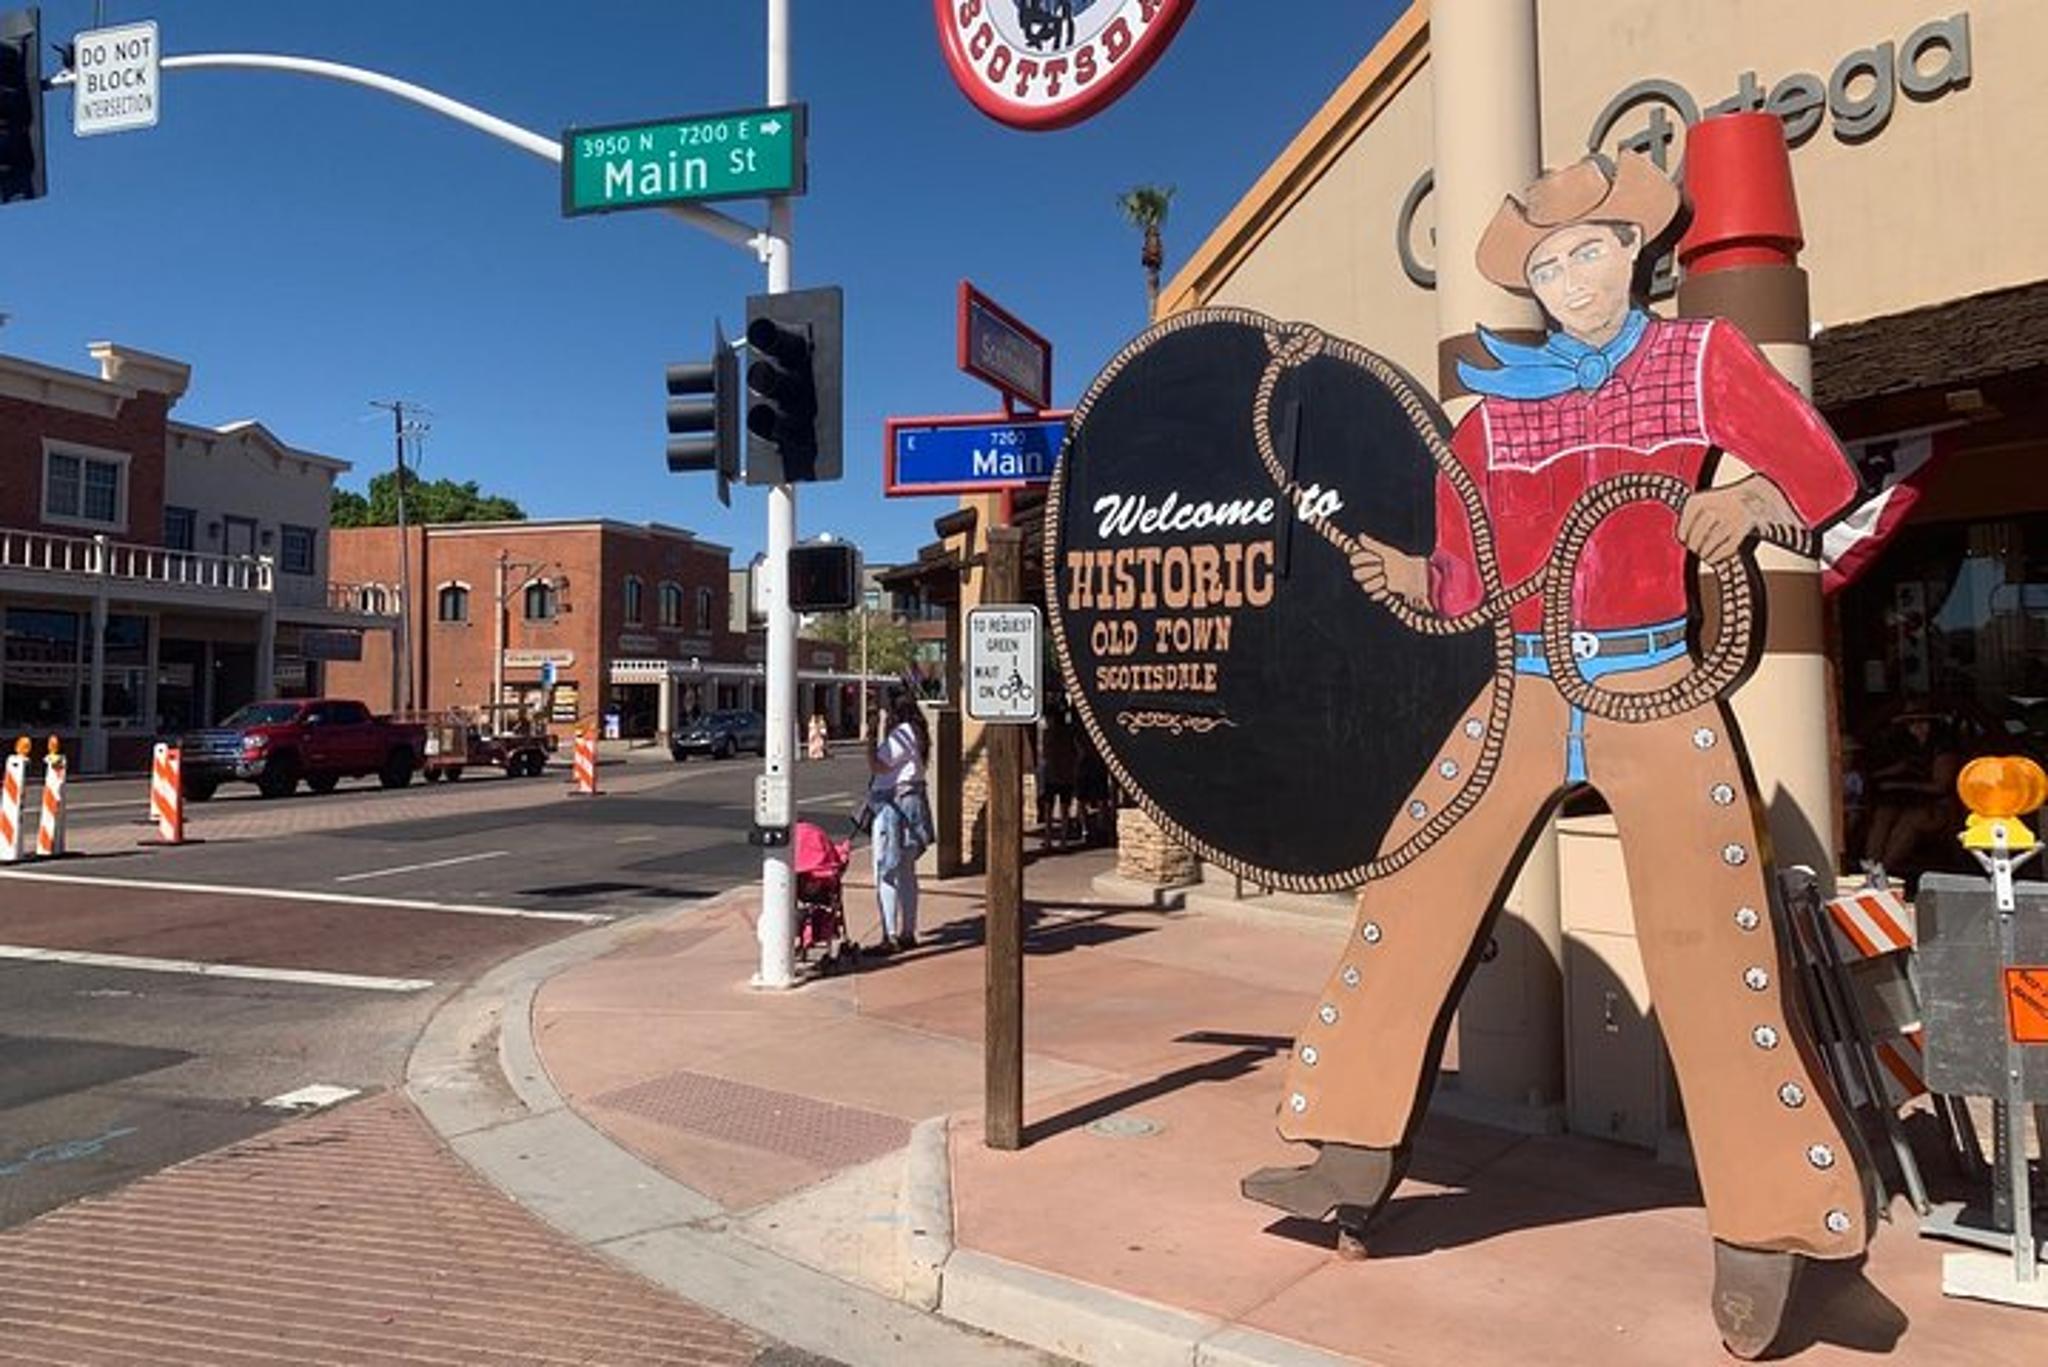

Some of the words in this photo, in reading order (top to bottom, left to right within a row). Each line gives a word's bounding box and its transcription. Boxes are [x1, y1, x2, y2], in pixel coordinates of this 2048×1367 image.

[82, 45, 106, 66] DO
[116, 37, 150, 60] NOT
[87, 67, 146, 93] BLOCK
[83, 94, 152, 118] INTERSECTION
[583, 136, 630, 158] 3950
[639, 133, 654, 151] N
[679, 123, 728, 145] 7200
[737, 121, 750, 140] E
[605, 151, 708, 199] Main
[729, 146, 757, 174] St
[990, 430, 1026, 446] 7200
[972, 448, 1042, 477] Main
[1094, 491, 1275, 538] Welcome
[1298, 483, 1344, 520] to
[1068, 540, 1275, 610] HISTORIC
[974, 618, 986, 633] TO
[988, 618, 1032, 633] REQUEST
[1091, 619, 1139, 656] OLD
[1155, 615, 1233, 653] TOWN
[985, 638, 1019, 653] GREEN
[975, 665, 1000, 679] WAIT
[1096, 662, 1218, 692] SCOTTSDALE
[979, 686, 995, 699] ON
